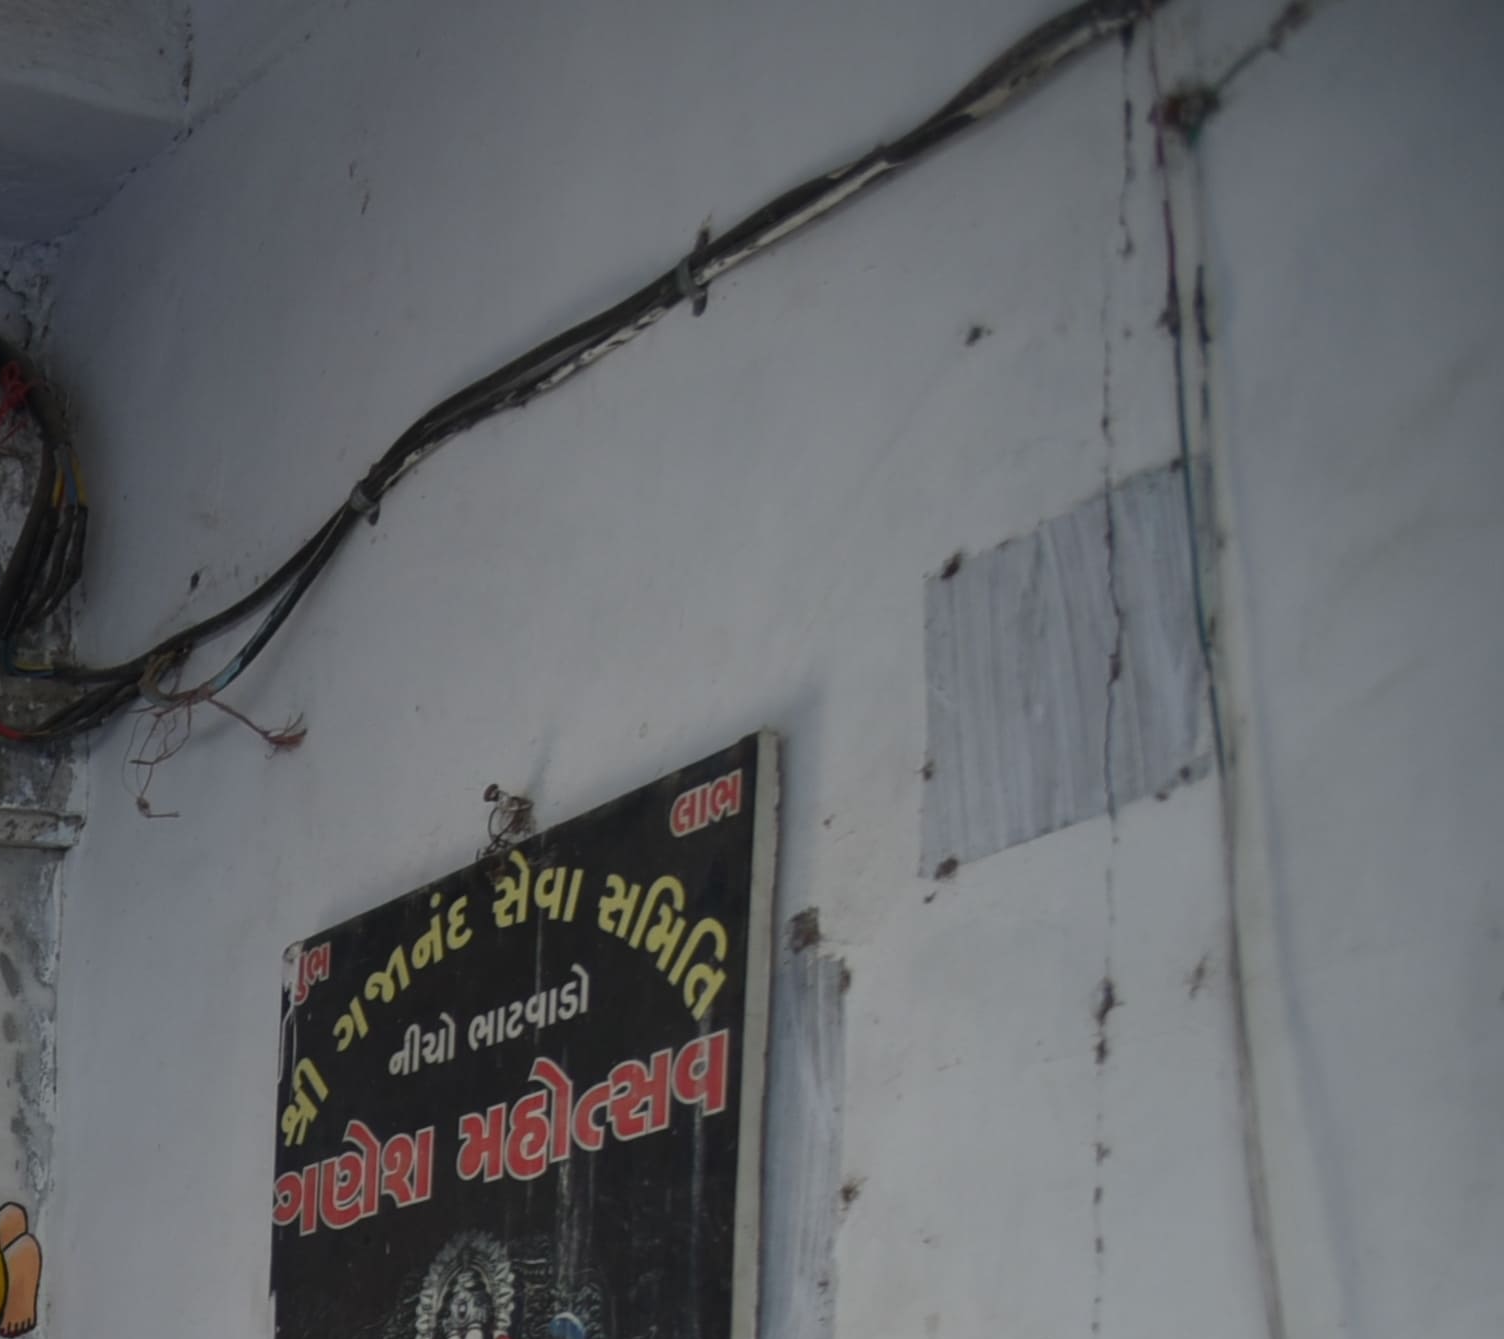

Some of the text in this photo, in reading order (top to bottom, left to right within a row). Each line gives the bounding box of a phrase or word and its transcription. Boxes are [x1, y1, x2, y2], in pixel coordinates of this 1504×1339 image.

[280, 1056, 329, 1147] શ્રી
[492, 851, 583, 930] સેવા
[596, 873, 728, 1022] સમિતિ
[271, 1028, 731, 1236] ગણેશ મહોત્સવ
